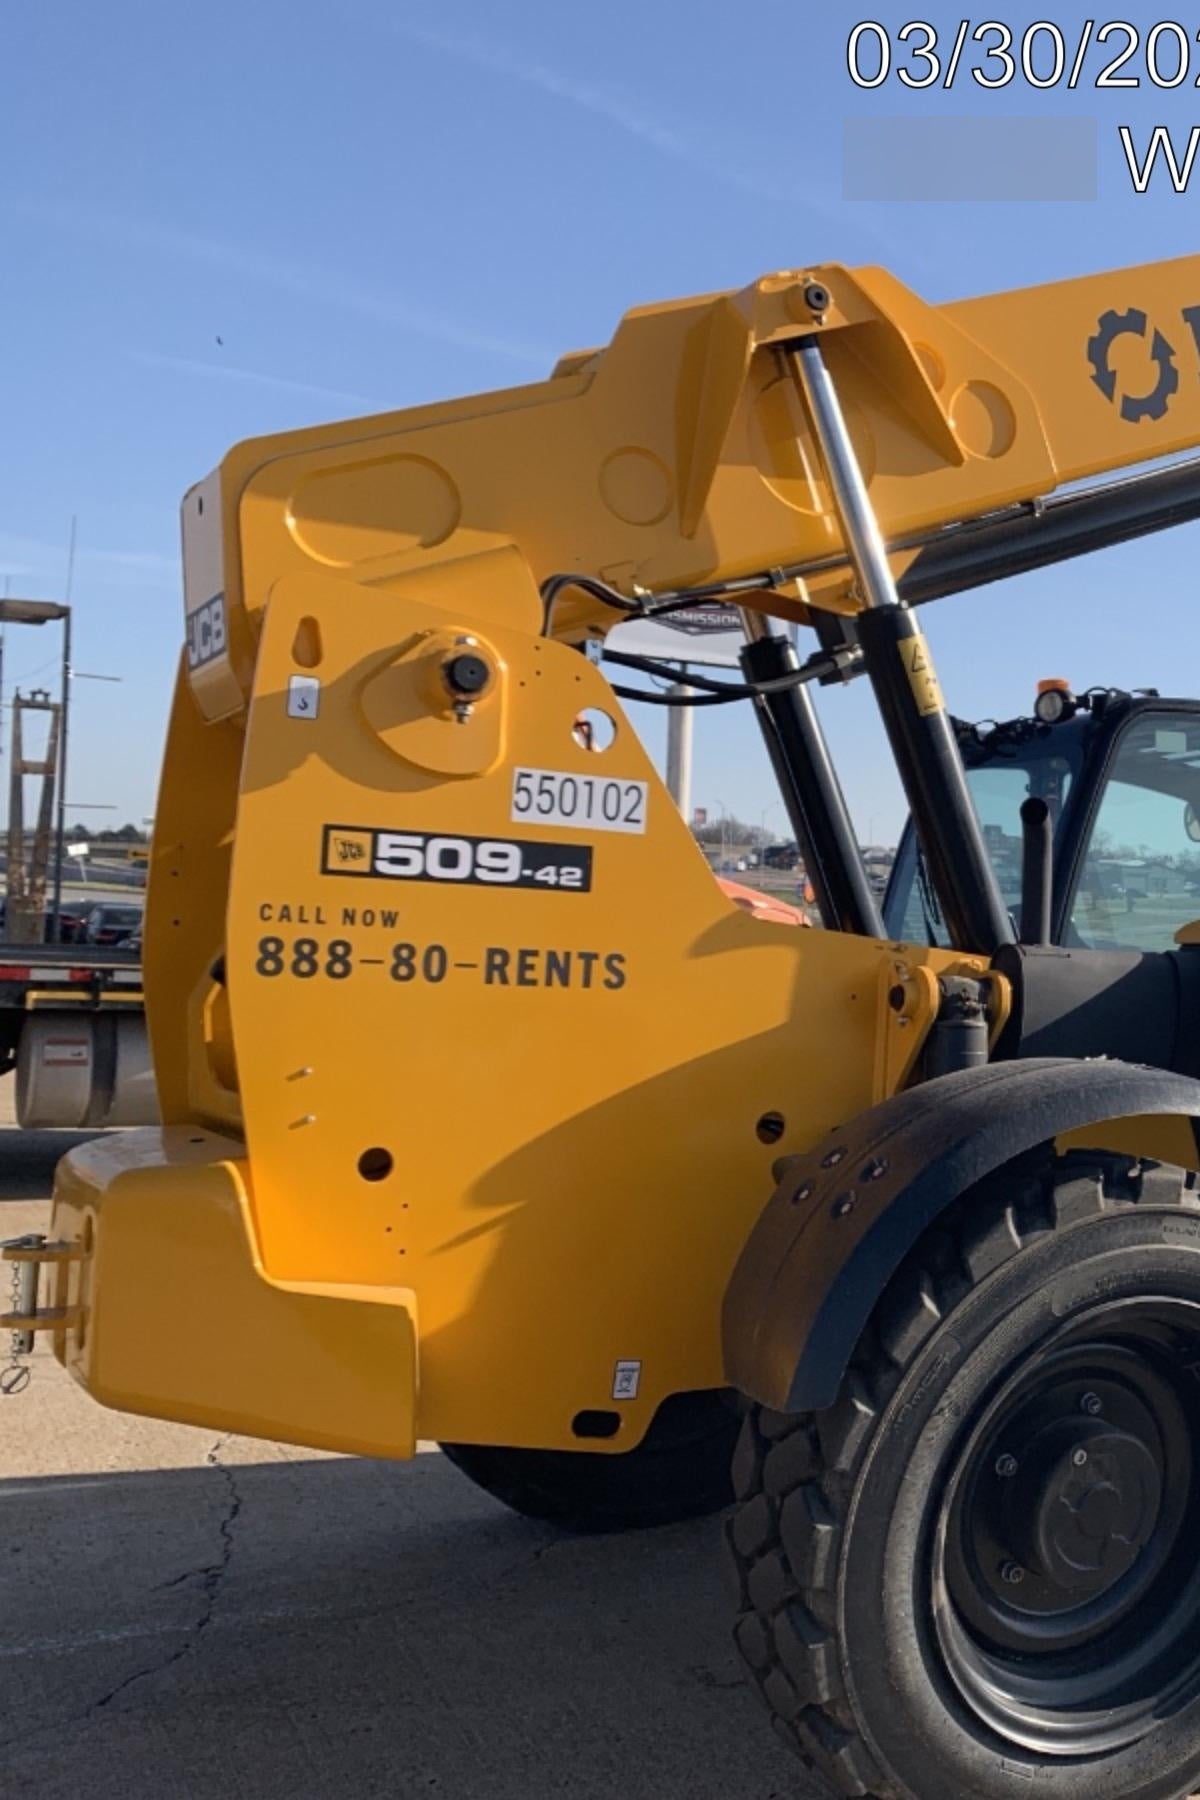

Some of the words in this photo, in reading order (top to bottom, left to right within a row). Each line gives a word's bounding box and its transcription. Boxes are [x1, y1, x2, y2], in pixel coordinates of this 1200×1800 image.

[186, 597, 226, 670] JCB
[513, 773, 643, 826] 550102
[374, 833, 583, 887] 509-42
[258, 904, 327, 926] CALL
[342, 908, 400, 929] NOW
[255, 936, 627, 990] 888-80-RENTS
